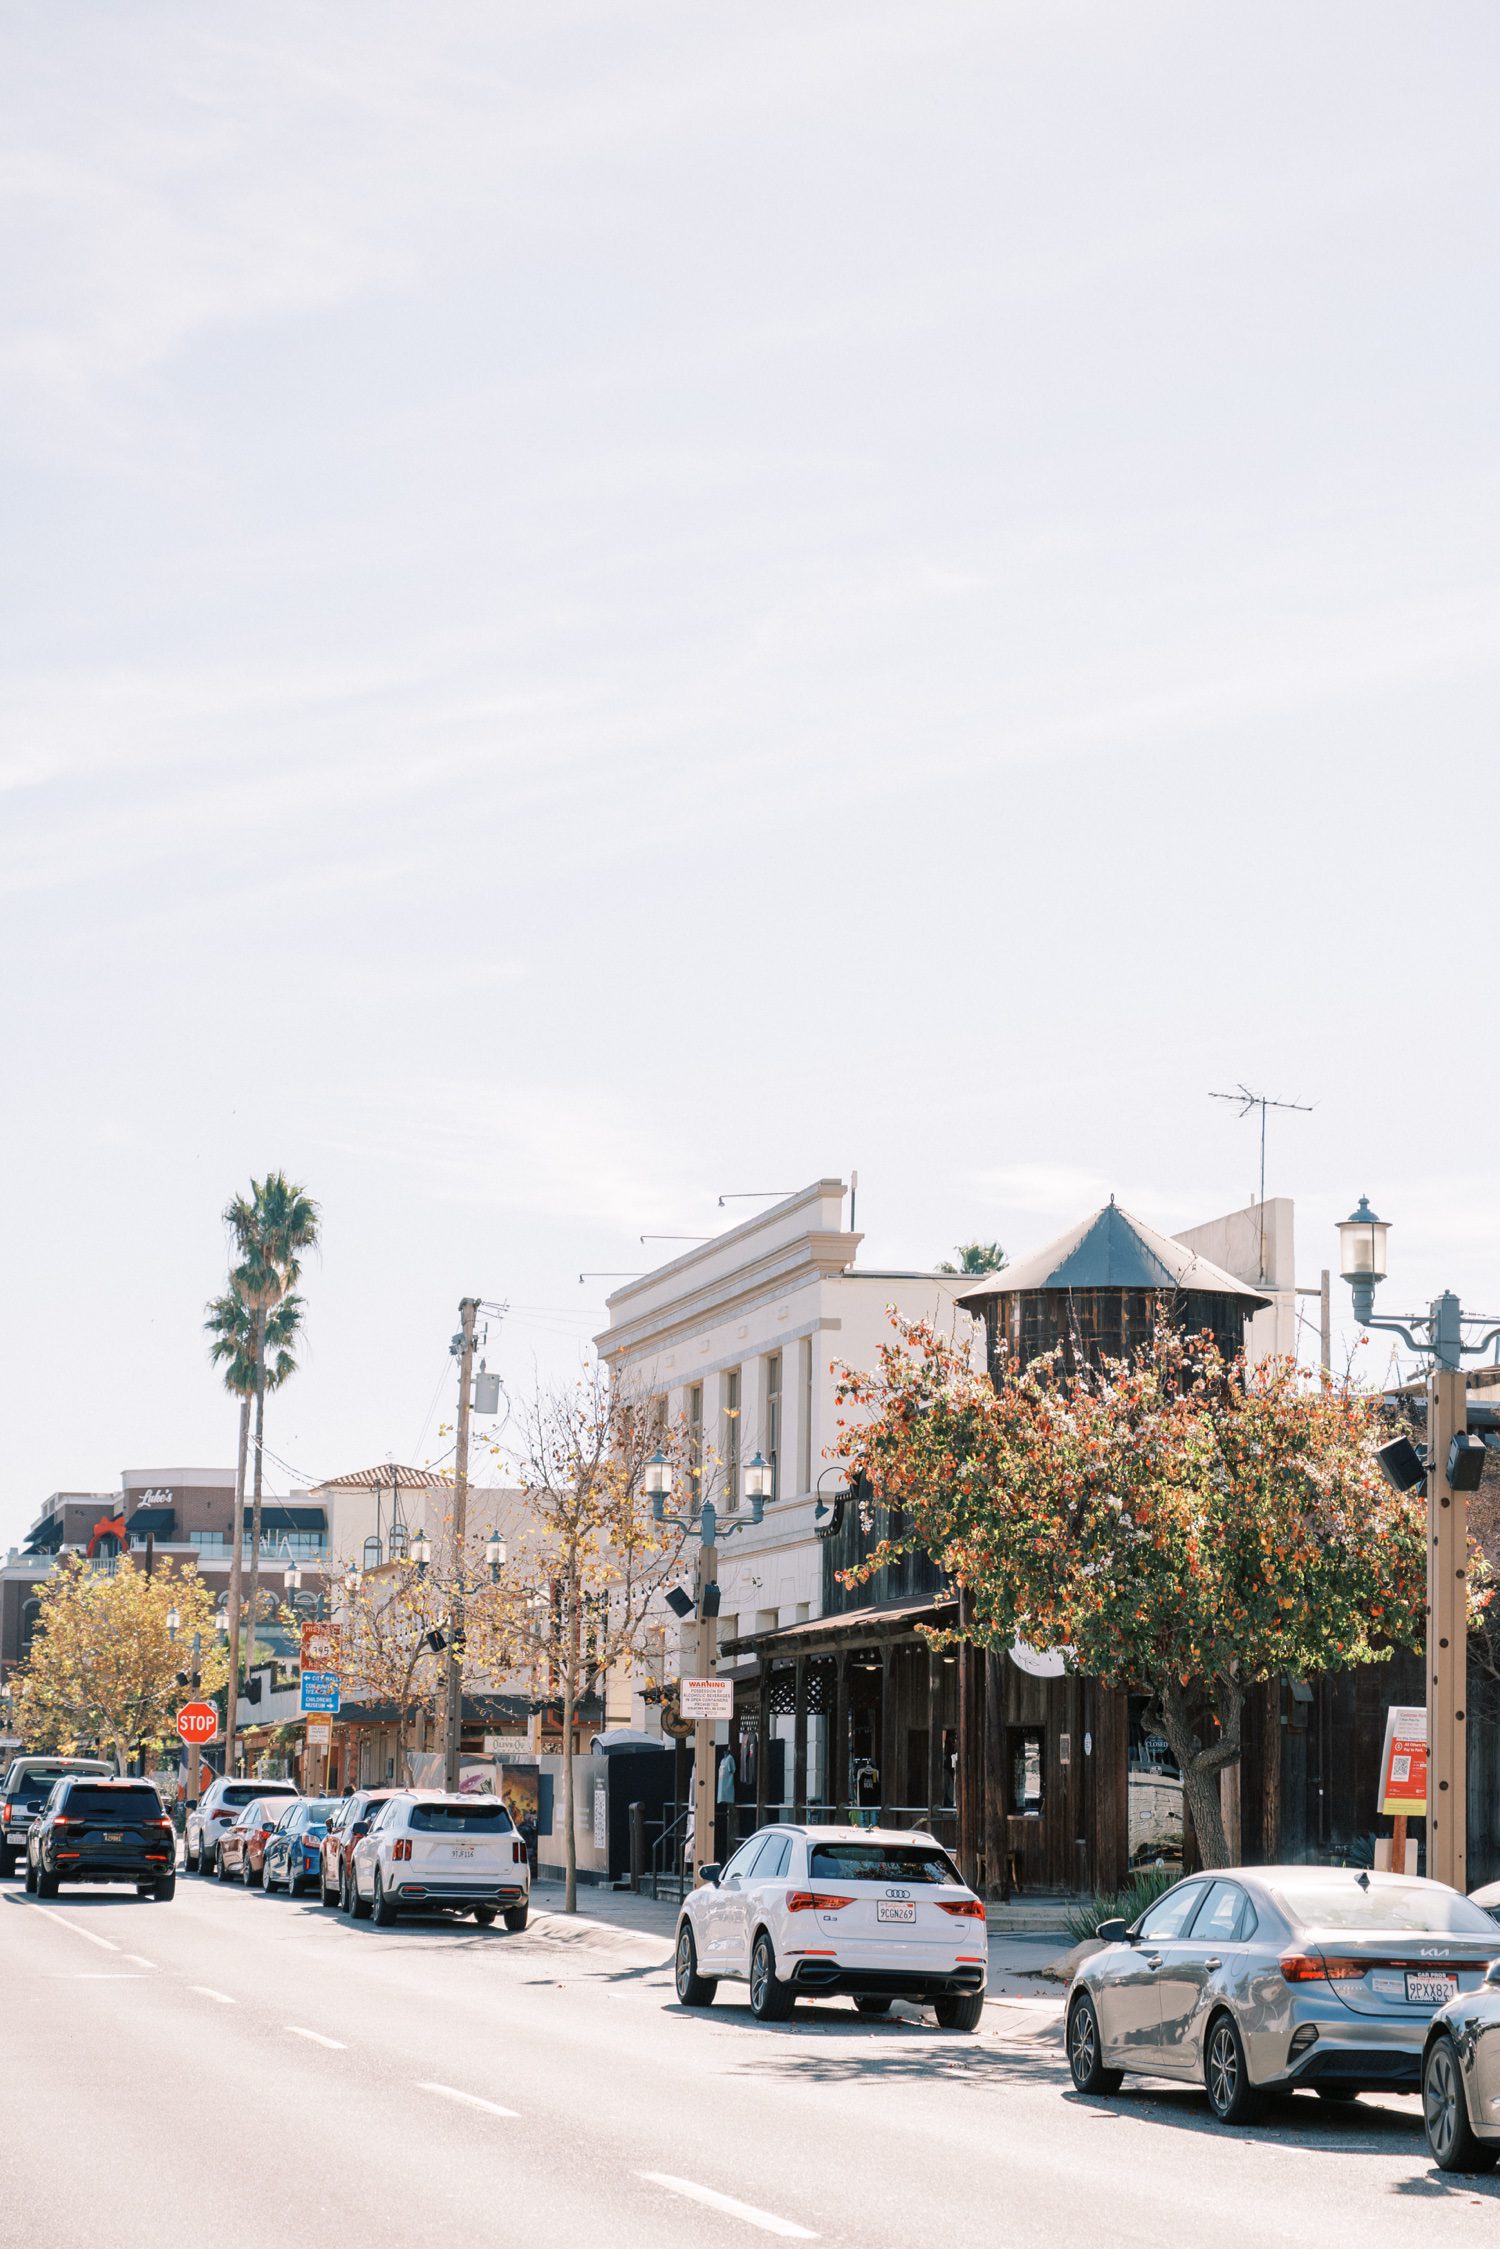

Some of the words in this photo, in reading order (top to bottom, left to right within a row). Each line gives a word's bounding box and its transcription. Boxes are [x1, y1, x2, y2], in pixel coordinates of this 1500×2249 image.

[137, 1489, 173, 1508] Luke's
[180, 1715, 215, 1731] STOP
[880, 1909, 913, 1919] 9CGN269
[1420, 1949, 1450, 1957] KIA
[1410, 1982, 1455, 1999] 9PXX821
